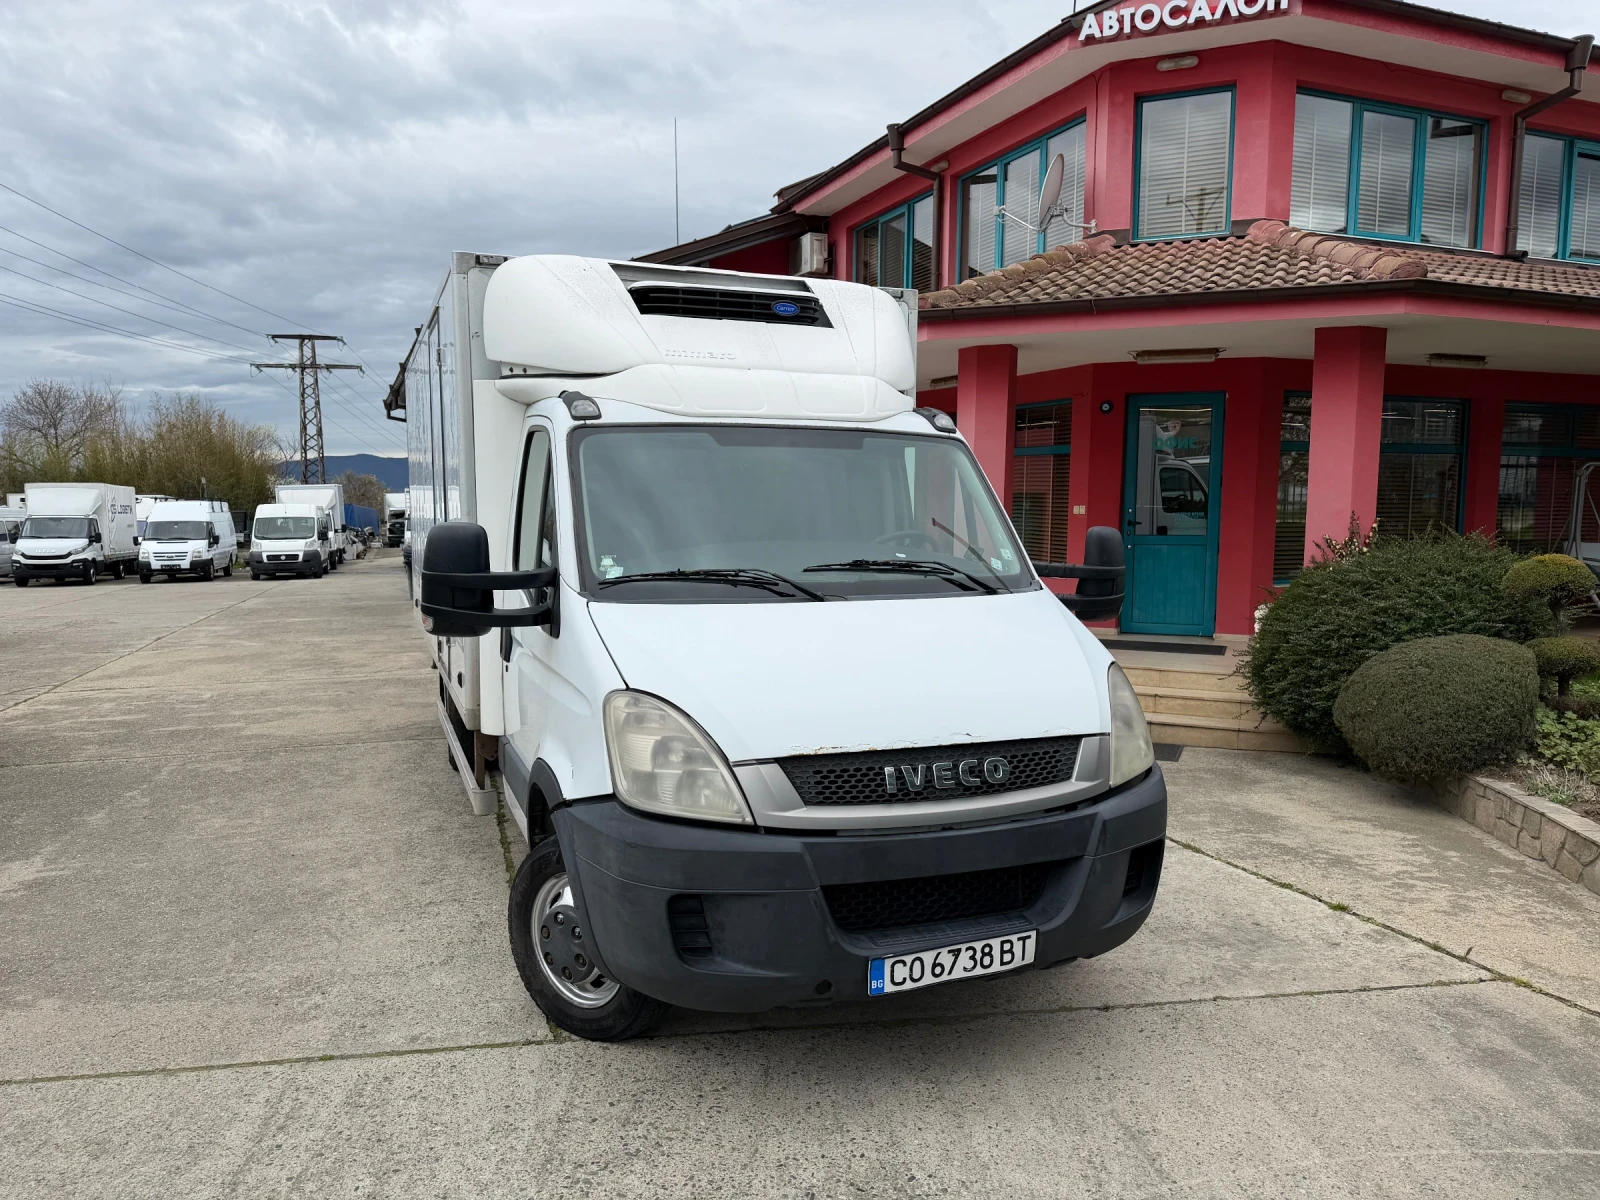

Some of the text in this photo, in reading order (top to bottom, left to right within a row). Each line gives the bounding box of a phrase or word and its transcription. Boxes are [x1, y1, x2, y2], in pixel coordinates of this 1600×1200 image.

[776, 304, 796, 312] Carrier
[1152, 436, 1198, 450] ОФИС
[884, 757, 1011, 795] IVECO
[871, 980, 884, 989] BG
